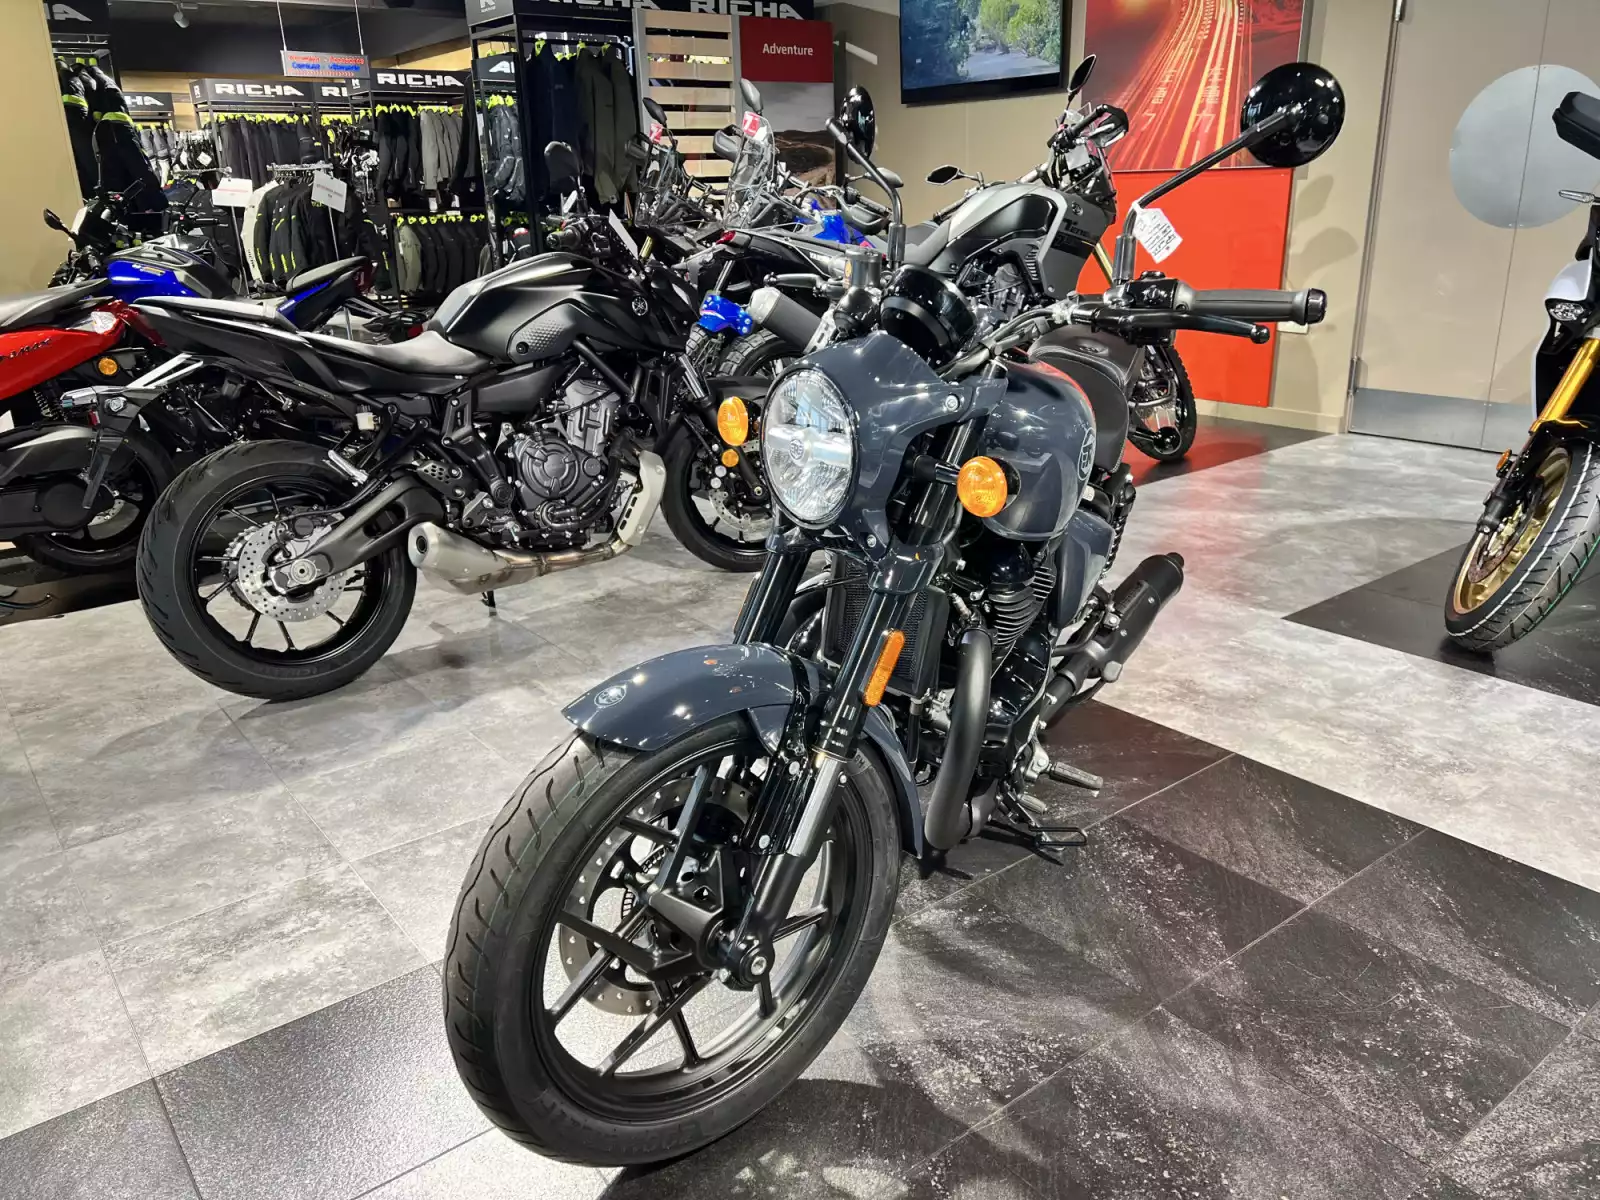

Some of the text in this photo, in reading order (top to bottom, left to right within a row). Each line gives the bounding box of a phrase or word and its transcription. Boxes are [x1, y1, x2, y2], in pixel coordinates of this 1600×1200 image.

[689, 0, 805, 20] RICHA
[762, 43, 814, 56] Adventure
[376, 73, 465, 87] RICHA
[214, 83, 305, 97] RICHA
